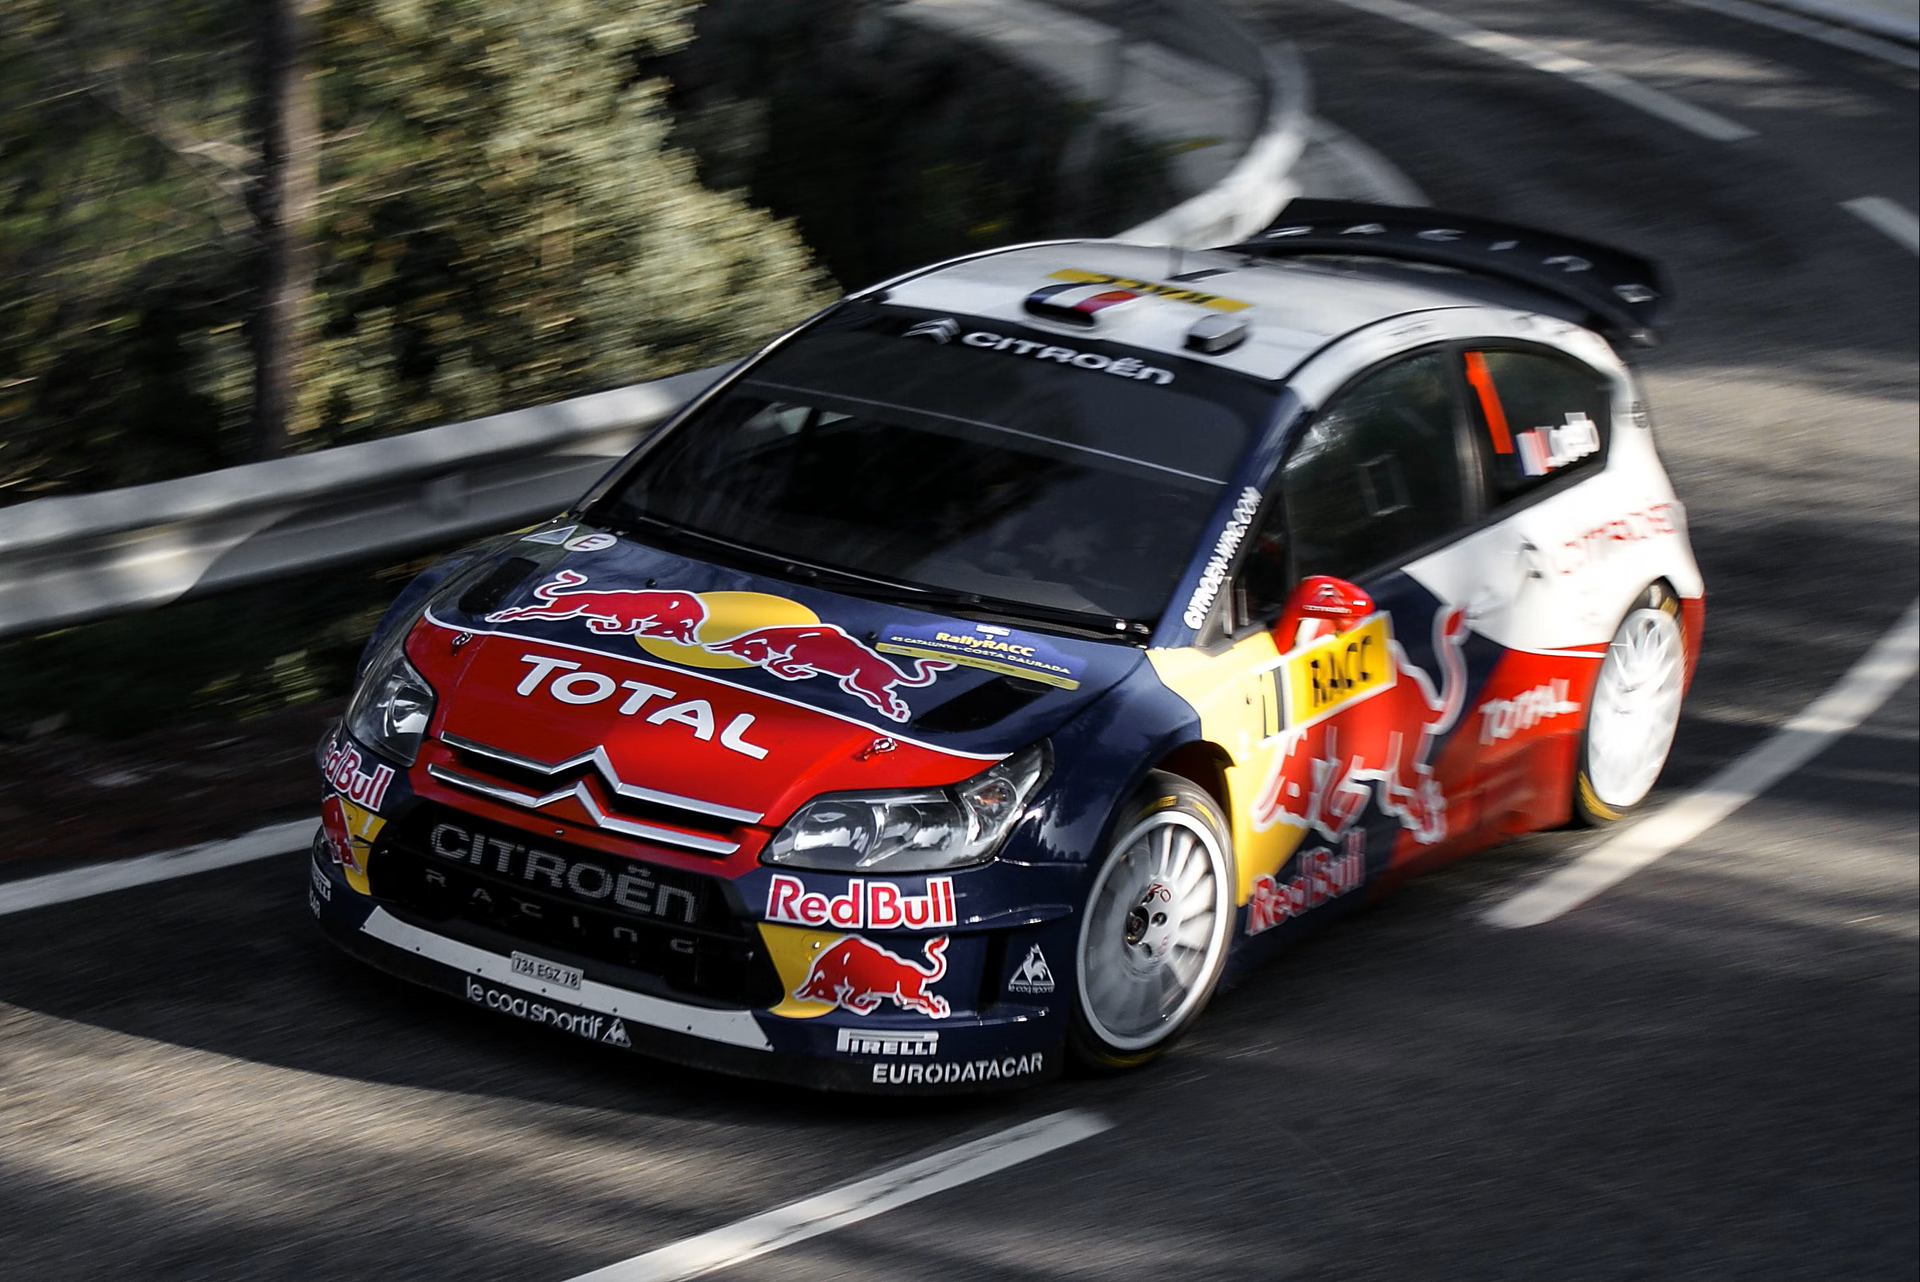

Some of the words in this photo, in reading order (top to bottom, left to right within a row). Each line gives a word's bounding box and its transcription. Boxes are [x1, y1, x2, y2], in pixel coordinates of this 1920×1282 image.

[572, 535, 609, 550] E
[935, 632, 1036, 658] RallyRACC
[1007, 655, 1071, 675] DAURADA
[516, 653, 769, 760] TOTAL
[335, 748, 394, 812] Bull
[766, 874, 864, 928] Red
[867, 876, 957, 930] Bull
[514, 957, 534, 976] 734
[537, 964, 561, 982] EGZ
[563, 970, 579, 988] 78
[466, 976, 485, 1001] le
[836, 1029, 940, 1056] PIRELLI
[872, 1051, 1044, 1085] EURODATACAR
